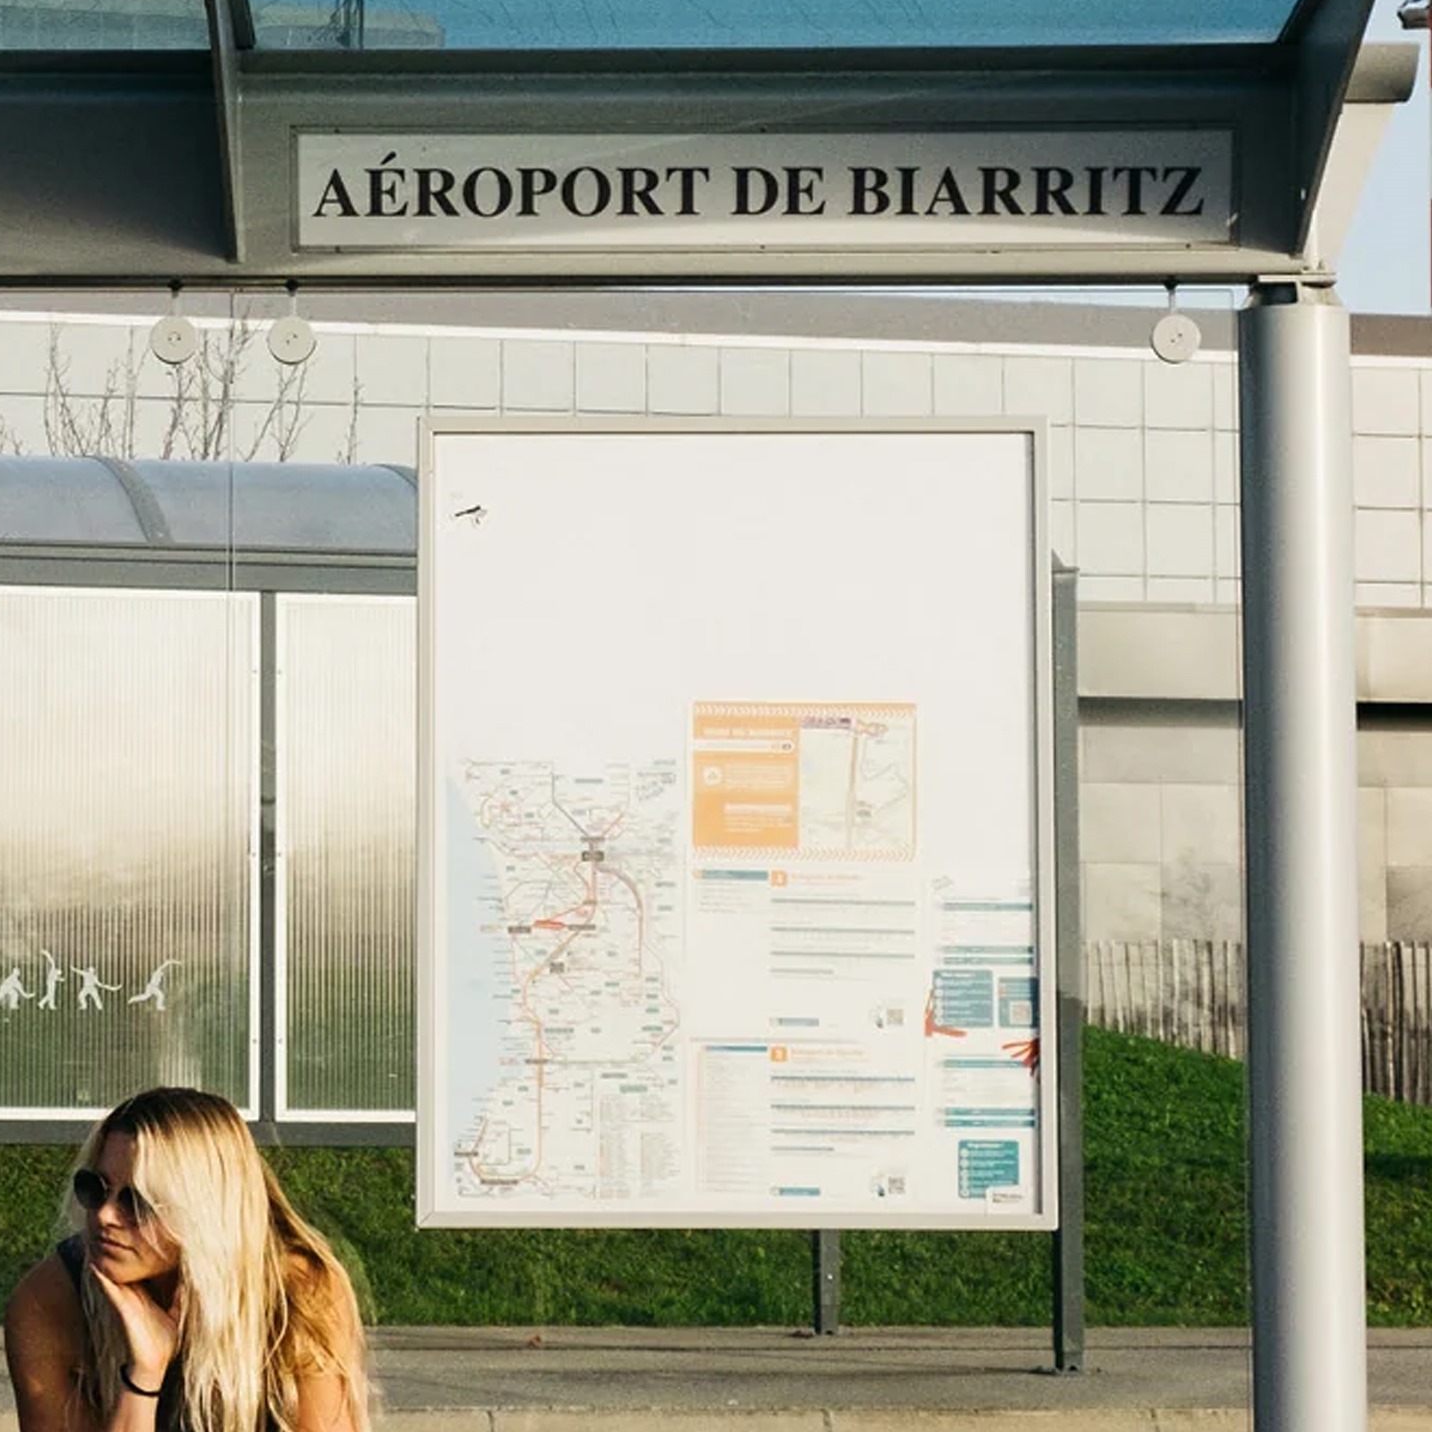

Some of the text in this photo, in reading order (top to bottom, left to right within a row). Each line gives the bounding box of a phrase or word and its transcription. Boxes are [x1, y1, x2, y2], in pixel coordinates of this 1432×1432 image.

[312, 152, 1205, 218] AÉROPORT DE BIARRITZ
